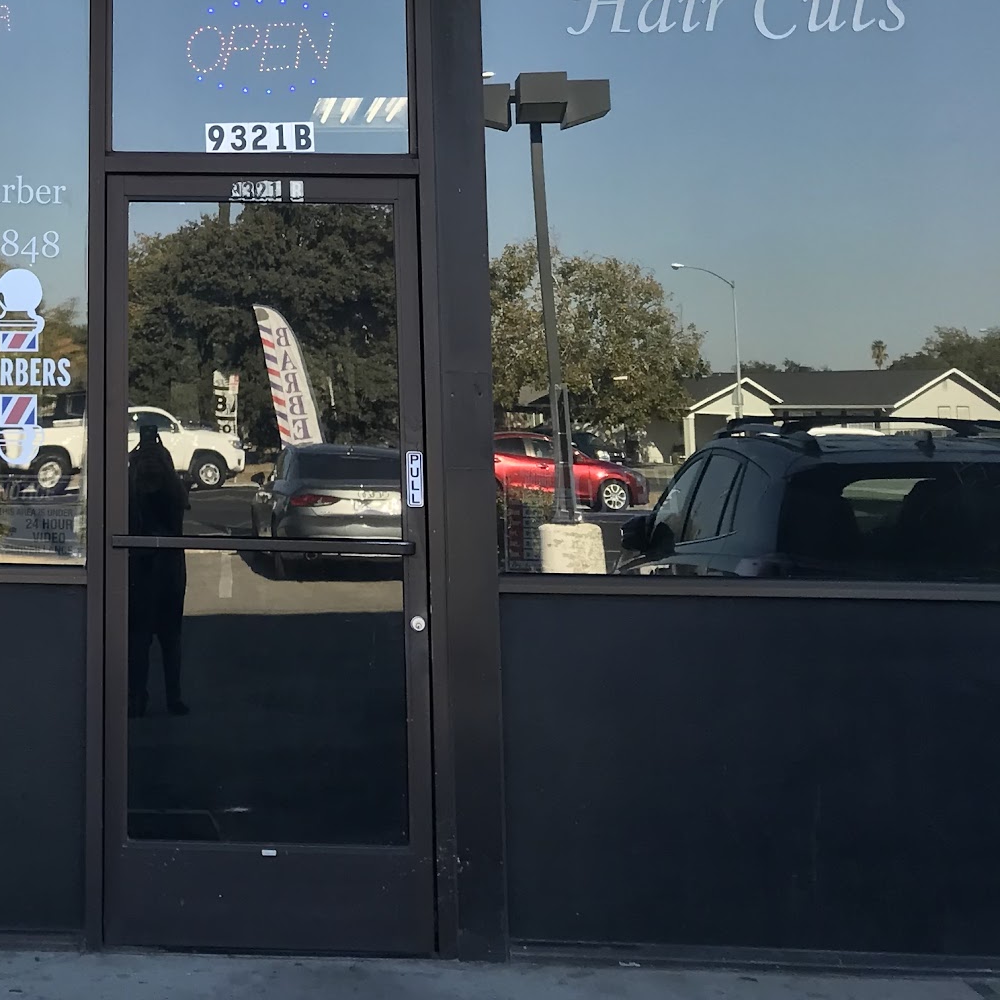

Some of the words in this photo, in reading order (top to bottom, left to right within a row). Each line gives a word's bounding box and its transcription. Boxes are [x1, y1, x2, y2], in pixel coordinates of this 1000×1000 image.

[186, 22, 335, 73] OPEN
[207, 124, 312, 151] 9321B
[408, 453, 422, 505] PULL
[25, 518, 39, 530] 24
[42, 518, 74, 531] HOUR
[32, 531, 67, 544] VIDEO
